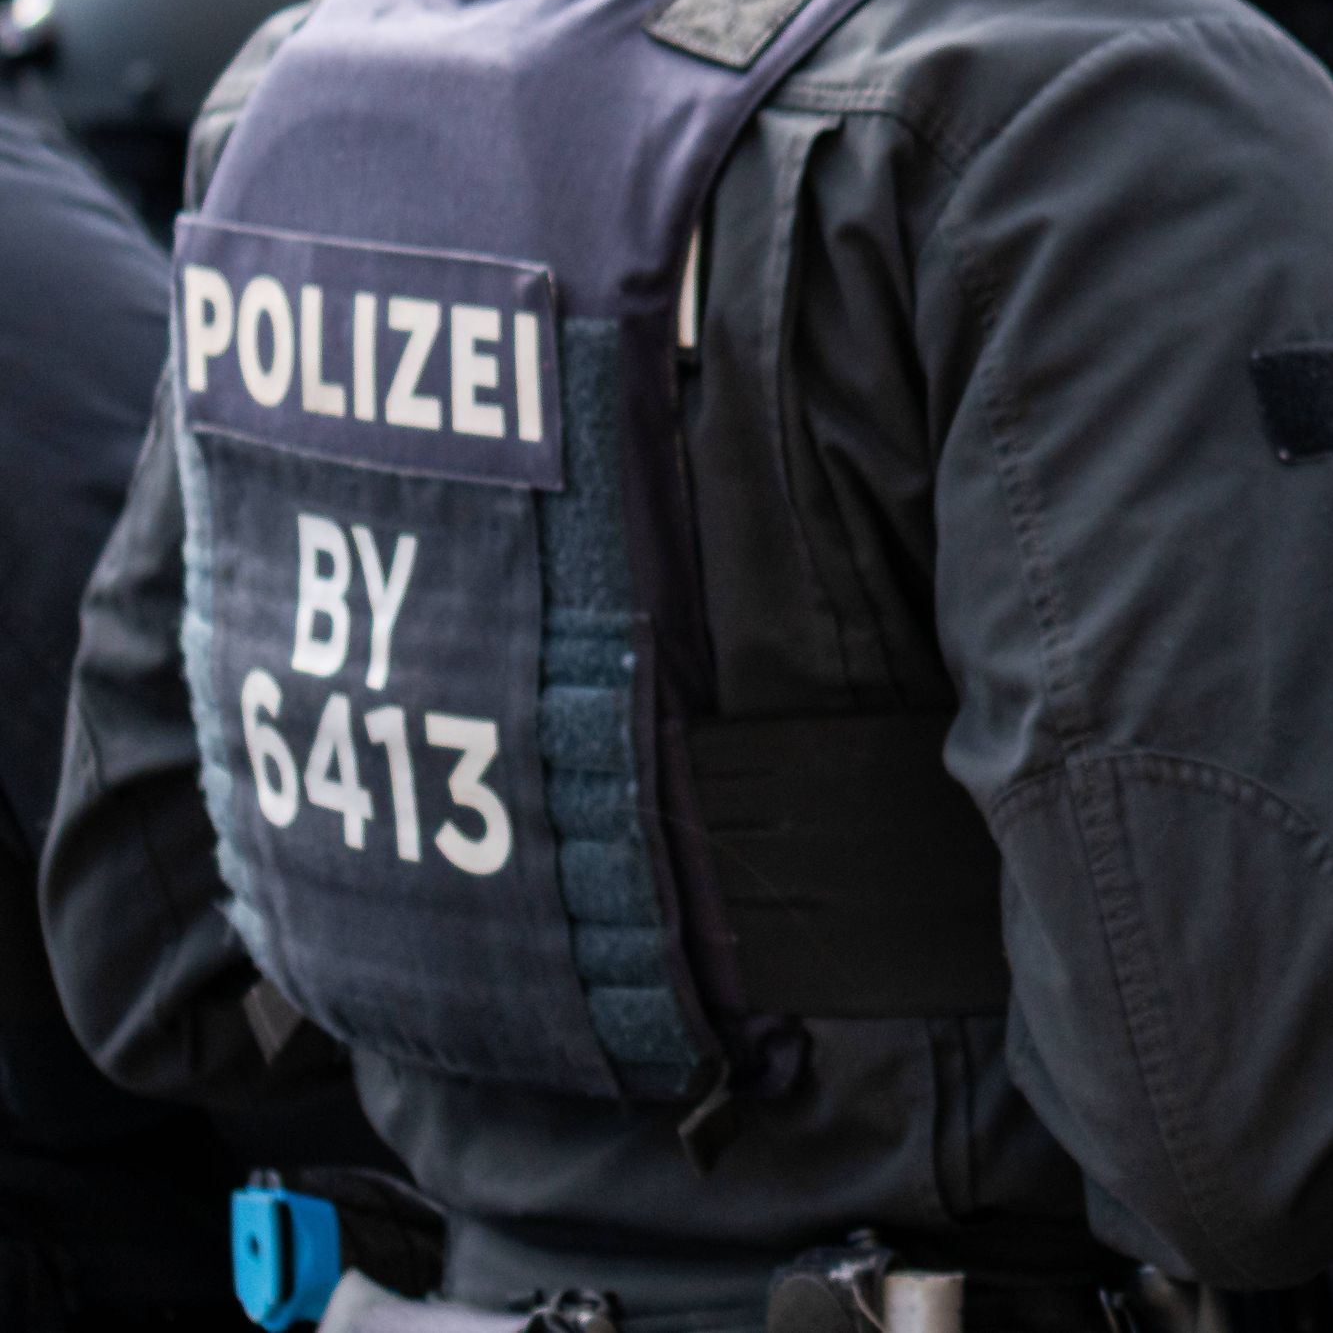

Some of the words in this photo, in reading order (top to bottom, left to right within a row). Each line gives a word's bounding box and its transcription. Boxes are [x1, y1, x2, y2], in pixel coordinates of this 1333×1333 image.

[182, 263, 543, 443] POLIZEI
[290, 513, 418, 692] BY
[240, 667, 513, 875] 6413
